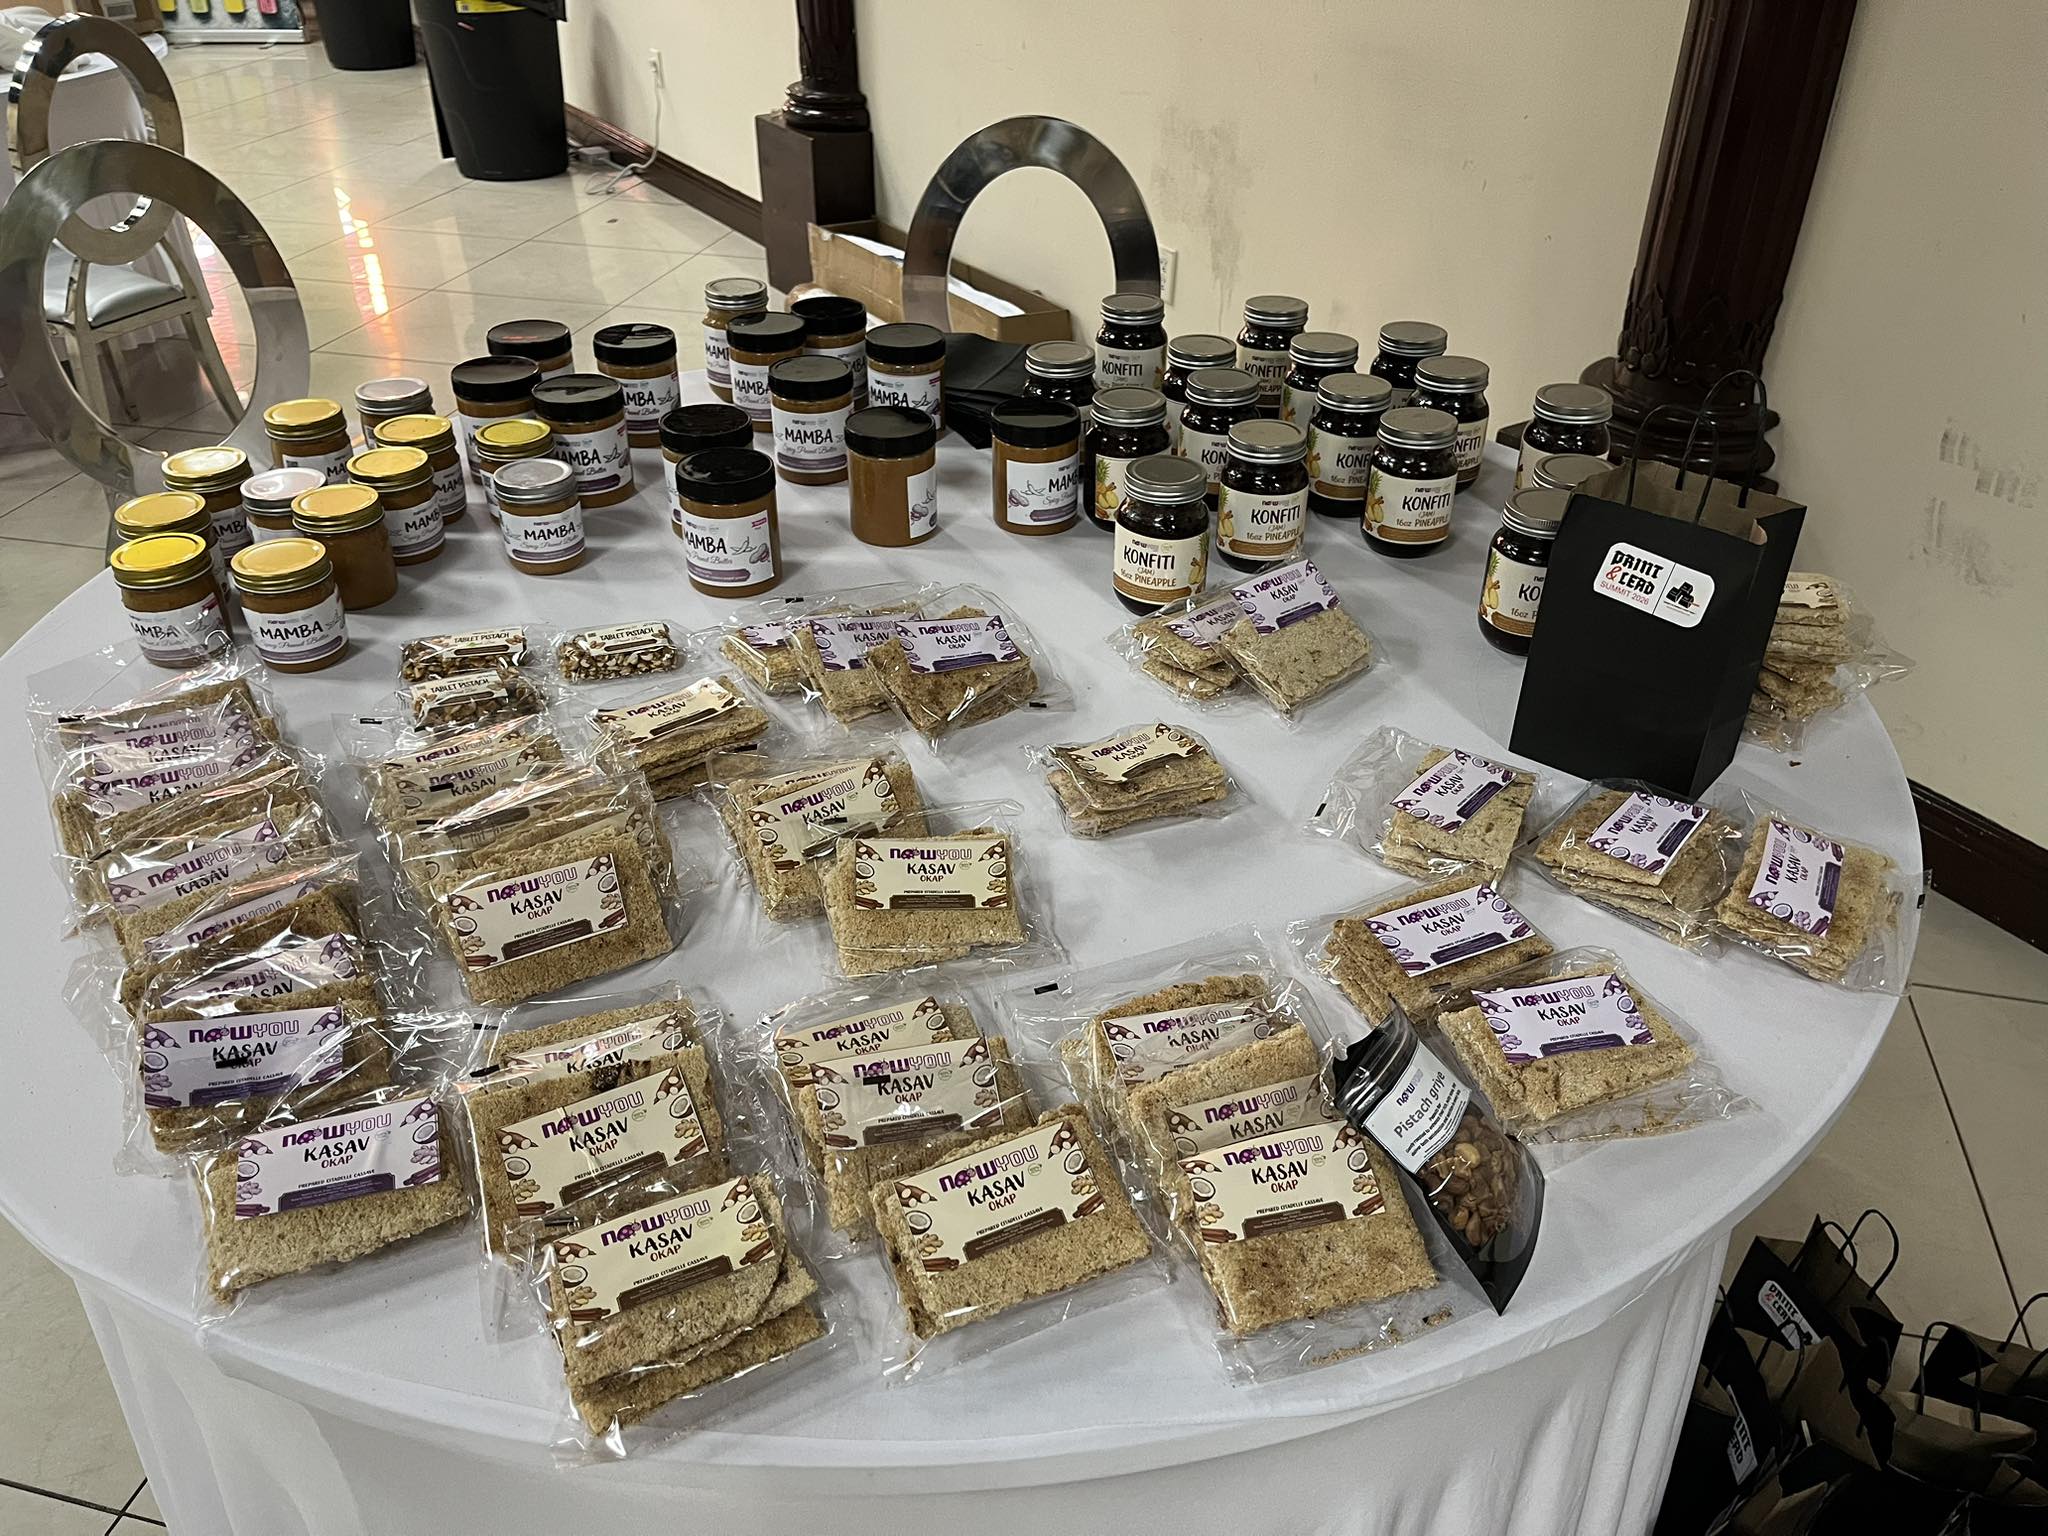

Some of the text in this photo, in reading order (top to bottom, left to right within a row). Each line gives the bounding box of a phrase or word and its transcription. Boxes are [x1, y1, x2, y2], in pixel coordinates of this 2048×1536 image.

[706, 344, 730, 361] MAM
[1102, 360, 1142, 376] KONFITI
[623, 391, 656, 406] MBA
[870, 386, 910, 407] MAMBA
[784, 426, 832, 444] MAMBA
[1454, 436, 1481, 452] NFITI
[1336, 453, 1371, 468] KONF
[1402, 493, 1450, 511] KONFITI
[404, 511, 441, 533] MAMB
[1250, 505, 1300, 525] KONFITI
[1396, 518, 1412, 526] 16oz
[524, 522, 576, 540] MAMBA
[1124, 545, 1176, 570] KONFITI
[1610, 550, 1664, 579] PRINT
[1134, 574, 1176, 587] PINEAPPLE
[1606, 566, 1655, 596] & LEAD
[1270, 582, 1300, 600] KASAV
[1600, 581, 1649, 606] SUMMIT 2026
[1207, 612, 1236, 626] KASAV
[1511, 608, 1528, 618] 16oz
[260, 620, 324, 640] MAMBA
[480, 632, 510, 640] PISTACH
[600, 627, 654, 640] TABLET PISTACH
[854, 632, 890, 643] KASAV
[936, 634, 972, 645] KASAV
[430, 684, 458, 693] TABLET
[648, 701, 686, 718] KASAV
[1112, 744, 1148, 762] KASAV
[450, 775, 496, 796] KASAV
[1434, 774, 1464, 797] KASAV
[802, 798, 846, 825] KASAV
[1628, 813, 1656, 836] KASAV
[907, 862, 956, 875] KASAV
[1785, 854, 1802, 884] KASAV
[175, 864, 230, 896] KASAV
[920, 874, 944, 882] OKAP
[510, 888, 563, 916] KASAV
[528, 906, 552, 920] OKAP
[1422, 912, 1466, 934] KASAV
[1440, 925, 1462, 936] OKAP
[250, 979, 294, 998] ASAV
[1537, 1002, 1587, 1020] KASAV
[1557, 1016, 1580, 1027] OKAP
[836, 1028, 890, 1051] KASAV
[1168, 1028, 1220, 1048] KASAV
[212, 1041, 278, 1062] KASAV
[855, 1044, 881, 1056] OKAP
[877, 1074, 934, 1096] KASAV
[894, 1092, 922, 1104] OKAP
[1394, 1096, 1432, 1138] Pistach
[1430, 1071, 1446, 1101] griye
[1230, 1110, 1284, 1140] KASAV
[569, 1117, 628, 1152] KASAV
[304, 1136, 370, 1162] KASAV
[589, 1138, 618, 1156] OKAP
[321, 1154, 354, 1168] OKAP
[1251, 1159, 1309, 1185] KASAV
[967, 1170, 1025, 1207] KASAV
[1270, 1180, 1299, 1194] OKAP
[988, 1194, 1016, 1212] OKAP
[629, 1224, 693, 1258] KASAV
[650, 1244, 682, 1262] OKAP
